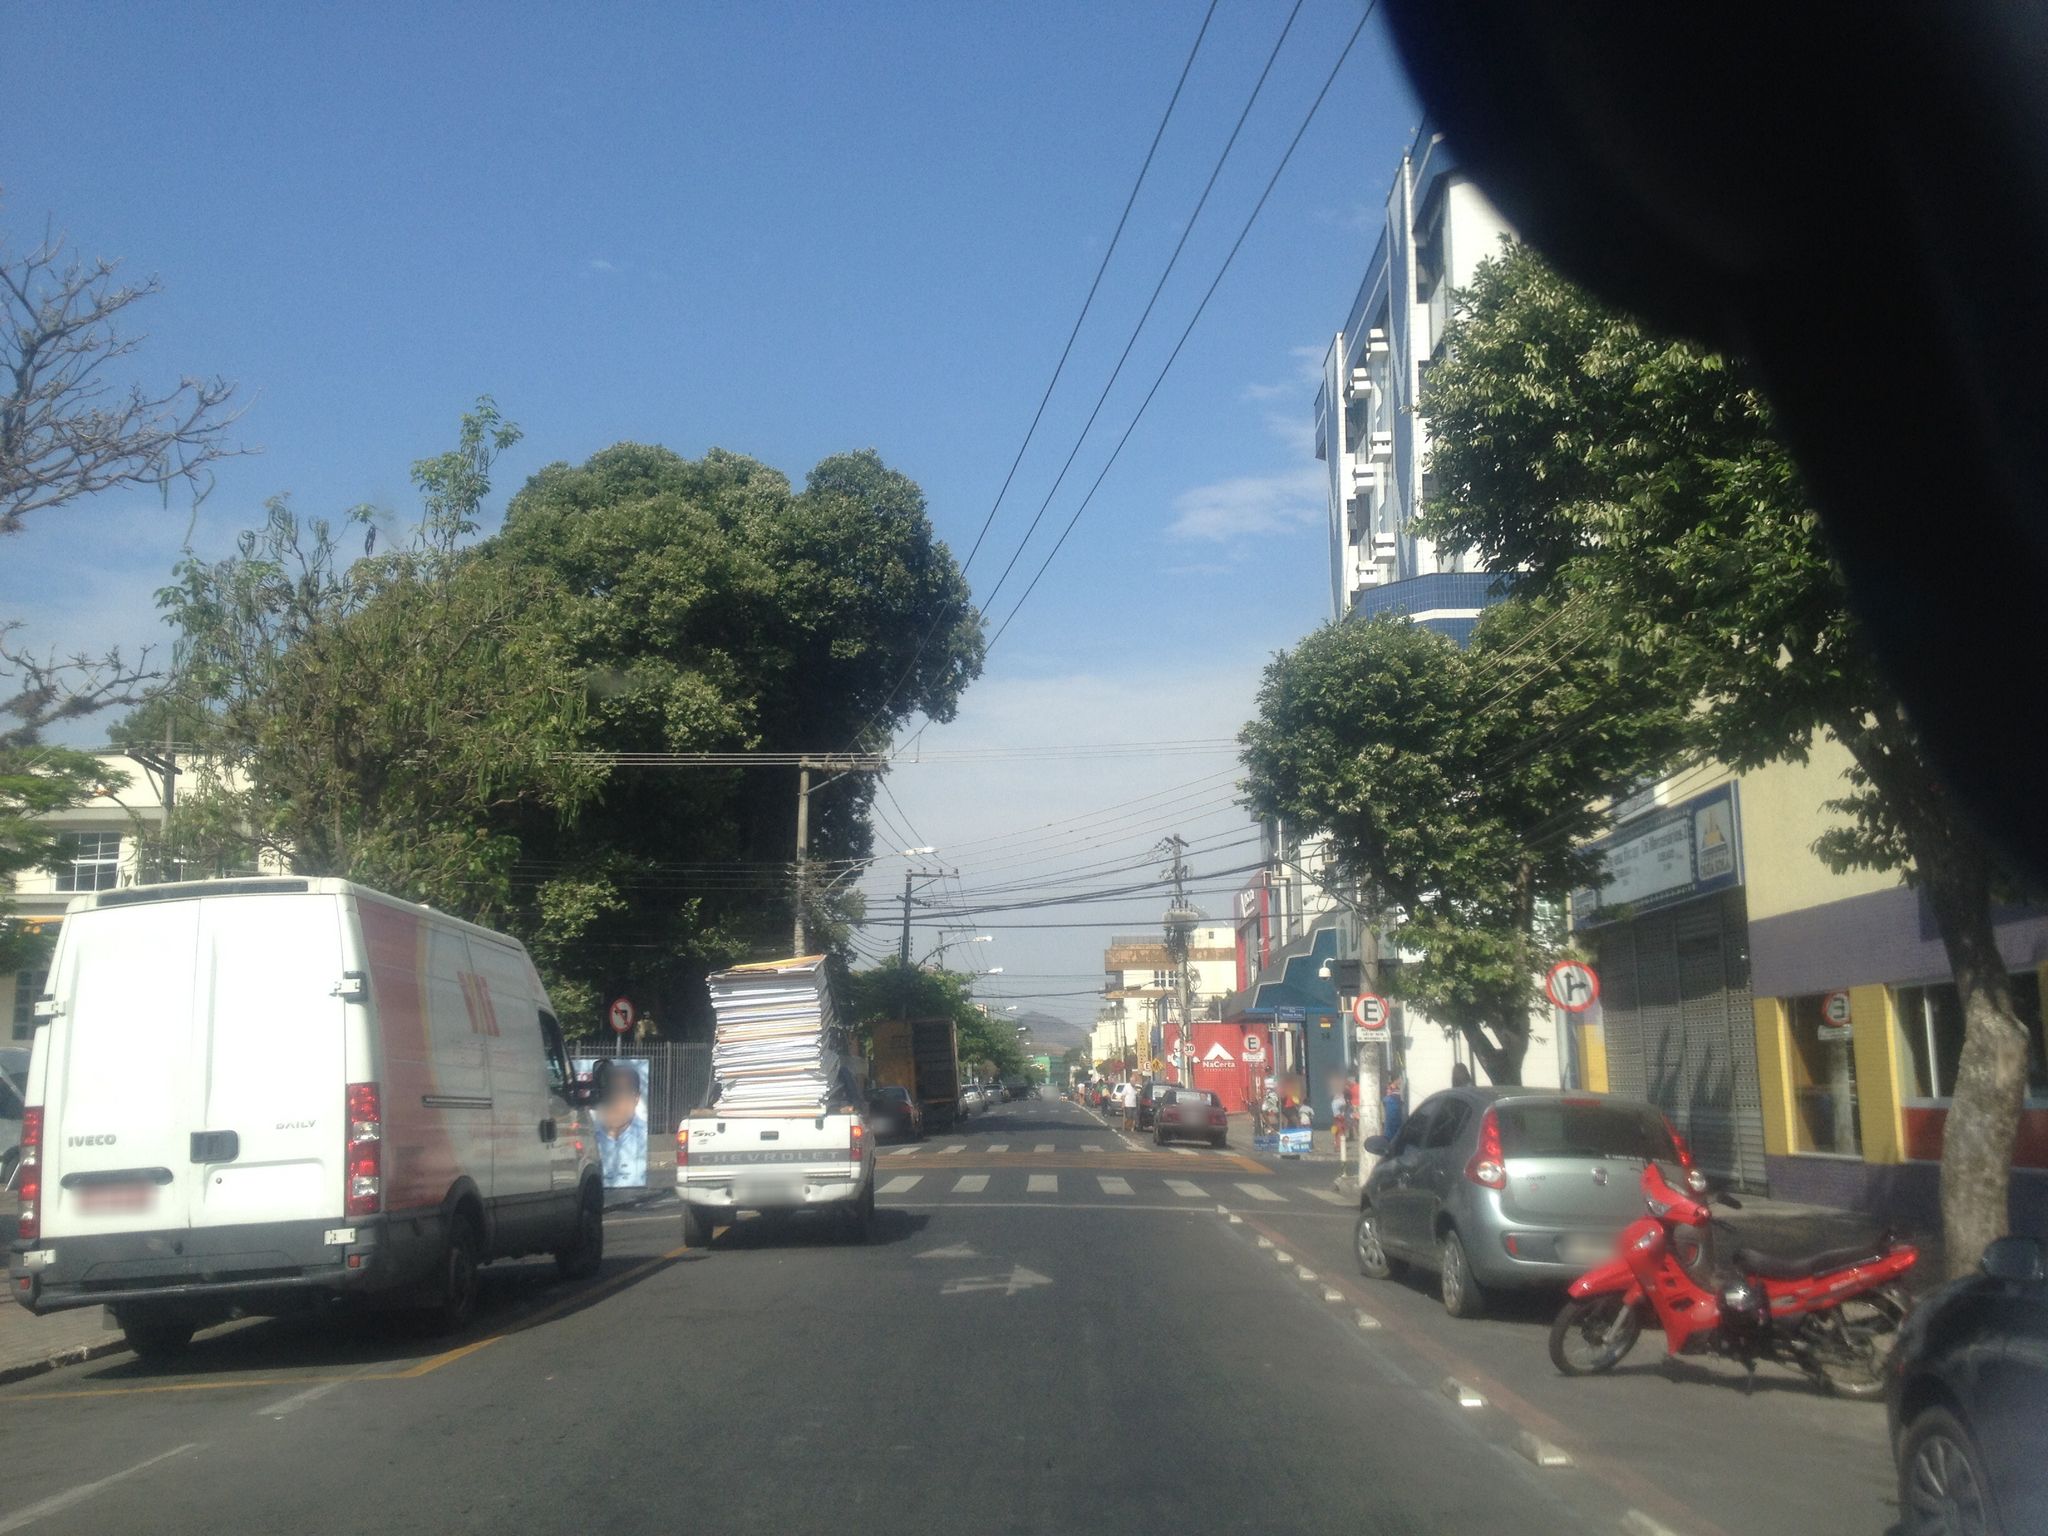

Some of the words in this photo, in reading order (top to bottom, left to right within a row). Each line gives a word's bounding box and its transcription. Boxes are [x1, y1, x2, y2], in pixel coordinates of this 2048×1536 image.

[1364, 1000, 1378, 1021] E
[1248, 1037, 1257, 1050] E
[68, 1133, 117, 1148] IVECO
[699, 1150, 840, 1164] CHEVROLET
